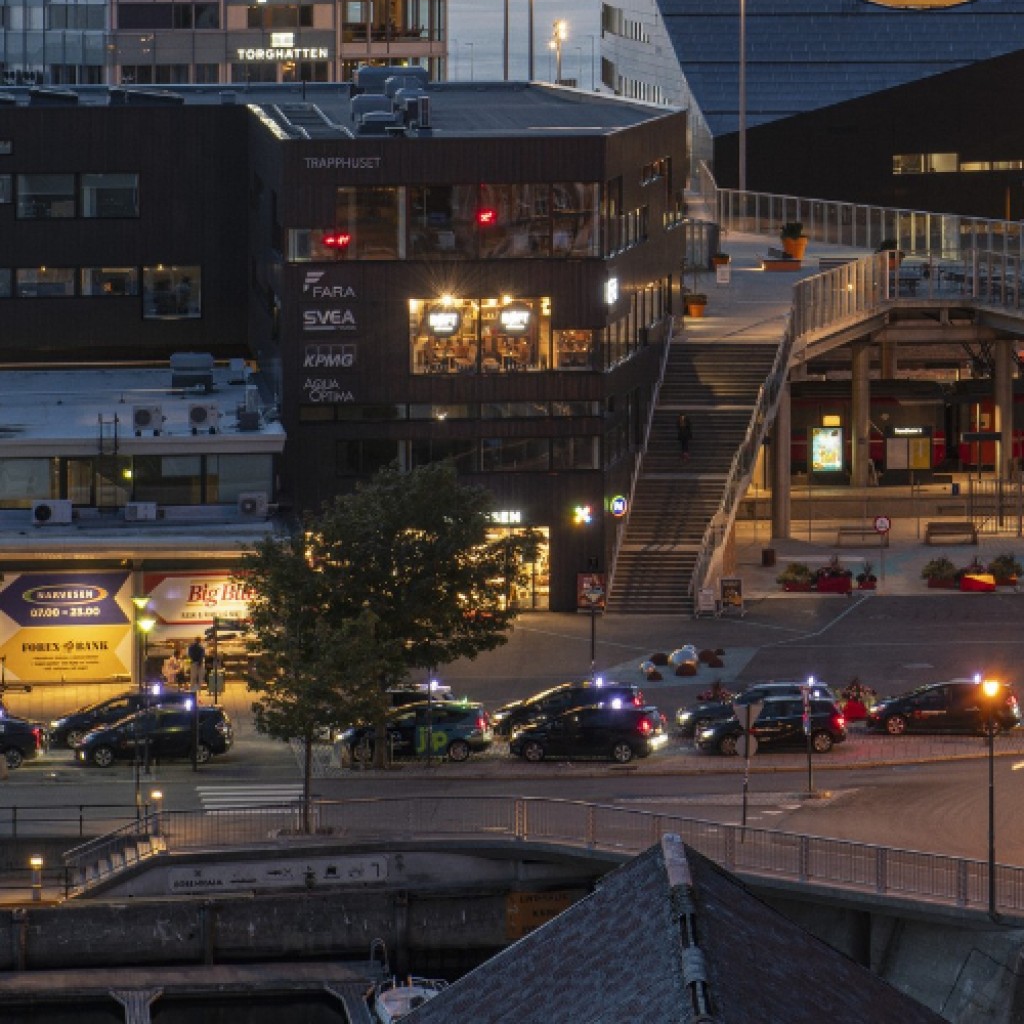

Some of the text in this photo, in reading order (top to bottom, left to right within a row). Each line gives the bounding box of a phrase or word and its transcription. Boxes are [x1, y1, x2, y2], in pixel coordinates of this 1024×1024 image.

[237, 48, 328, 60] TORGHATTEN
[304, 157, 381, 169] TRAPPHUSET
[312, 286, 357, 298] FARA
[303, 310, 357, 325] SVEA
[303, 353, 354, 368] KPMG
[187, 583, 218, 607] Big
[21, 640, 109, 653] FOREX BANK
